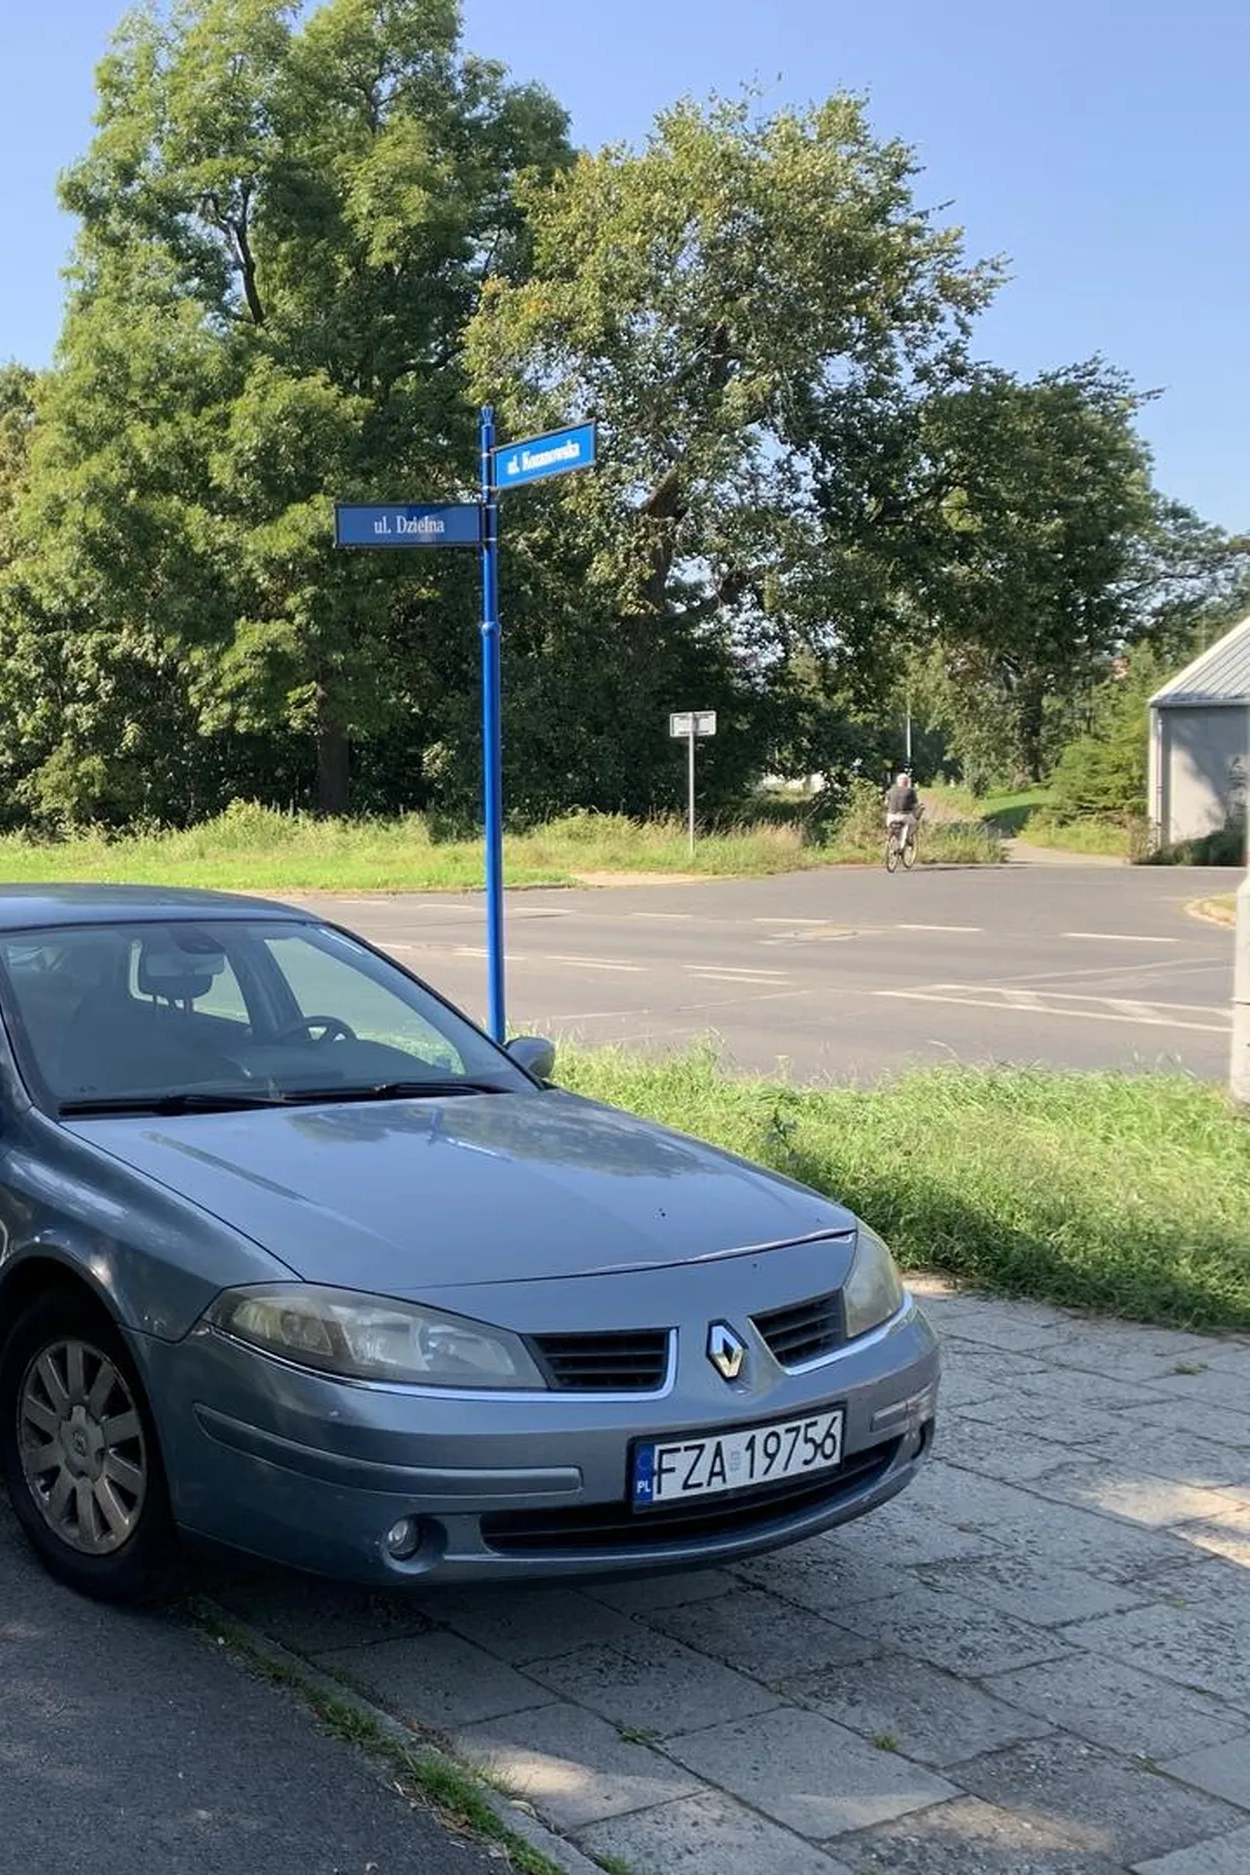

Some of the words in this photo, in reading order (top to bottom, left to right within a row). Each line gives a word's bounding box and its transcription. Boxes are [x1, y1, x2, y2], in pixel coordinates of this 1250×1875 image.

[374, 516, 391, 534] ul.
[396, 515, 445, 534] Dzielna
[656, 1440, 726, 1494] FZA
[746, 1416, 838, 1479] 19756
[637, 1480, 650, 1494] PL
